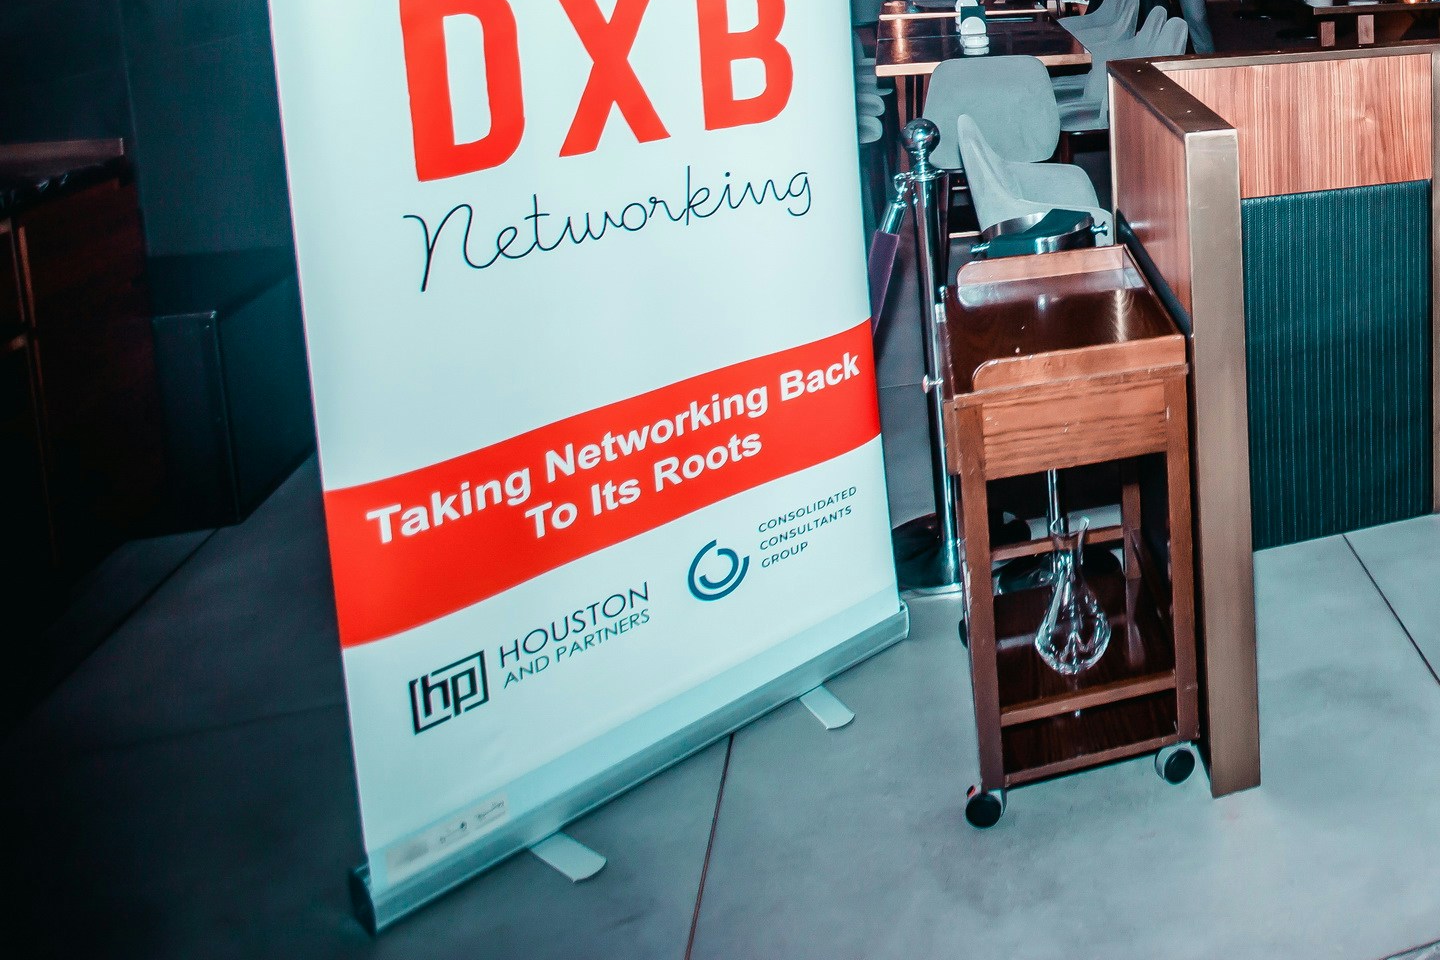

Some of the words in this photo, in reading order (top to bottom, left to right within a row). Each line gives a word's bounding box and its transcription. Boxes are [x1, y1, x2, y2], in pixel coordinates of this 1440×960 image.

[403, 165, 812, 293] Networking
[365, 467, 531, 544] Taking
[545, 385, 769, 484] Networking
[779, 351, 860, 402] Back
[524, 501, 578, 539] To
[591, 478, 641, 516] Its
[653, 431, 762, 493] Roots
[758, 486, 857, 533] CONSOLIDATED
[759, 505, 853, 551] CONSULTANTS
[761, 541, 809, 568] GROUP
[499, 581, 649, 669] HOUSTON
[503, 654, 550, 690] AND
[555, 608, 651, 663] PARTNERS
